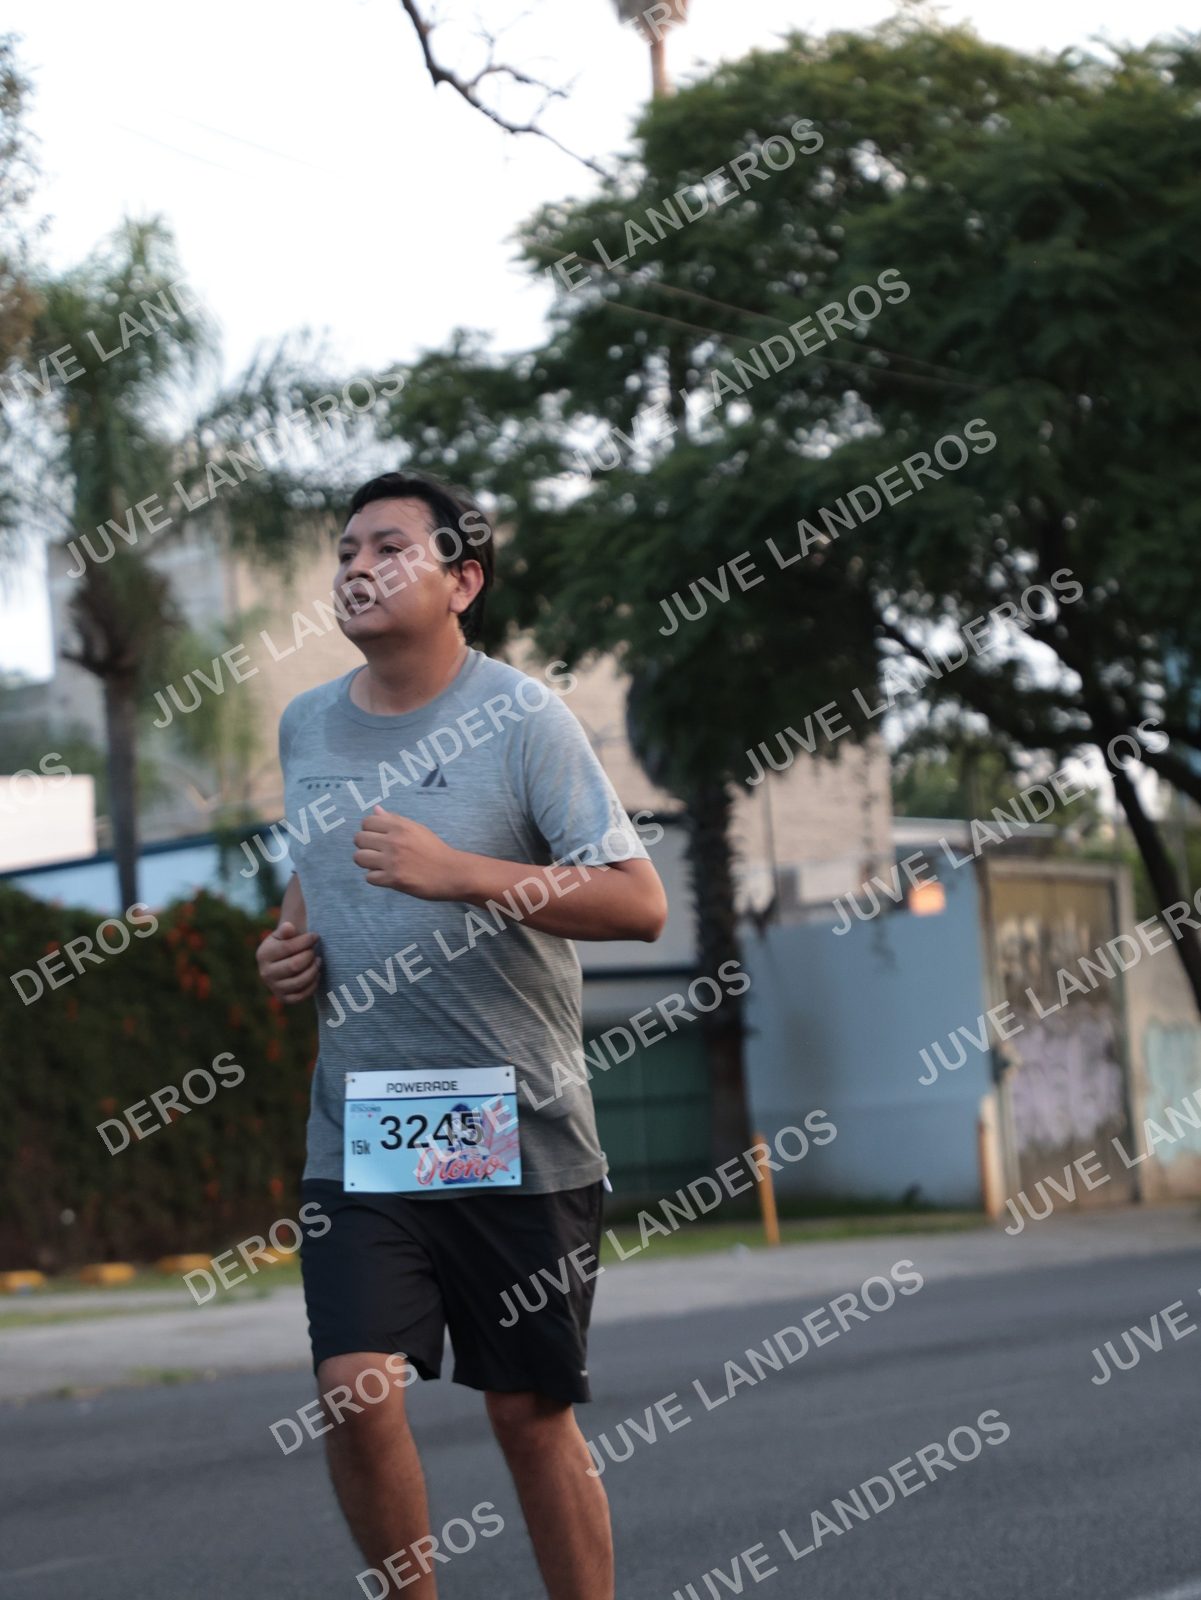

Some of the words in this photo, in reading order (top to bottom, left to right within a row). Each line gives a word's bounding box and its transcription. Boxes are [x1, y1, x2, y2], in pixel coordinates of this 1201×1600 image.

[386, 1081, 458, 1093] POWERADE
[380, 1113, 484, 1150] 3245
[352, 1140, 371, 1155] 15k
